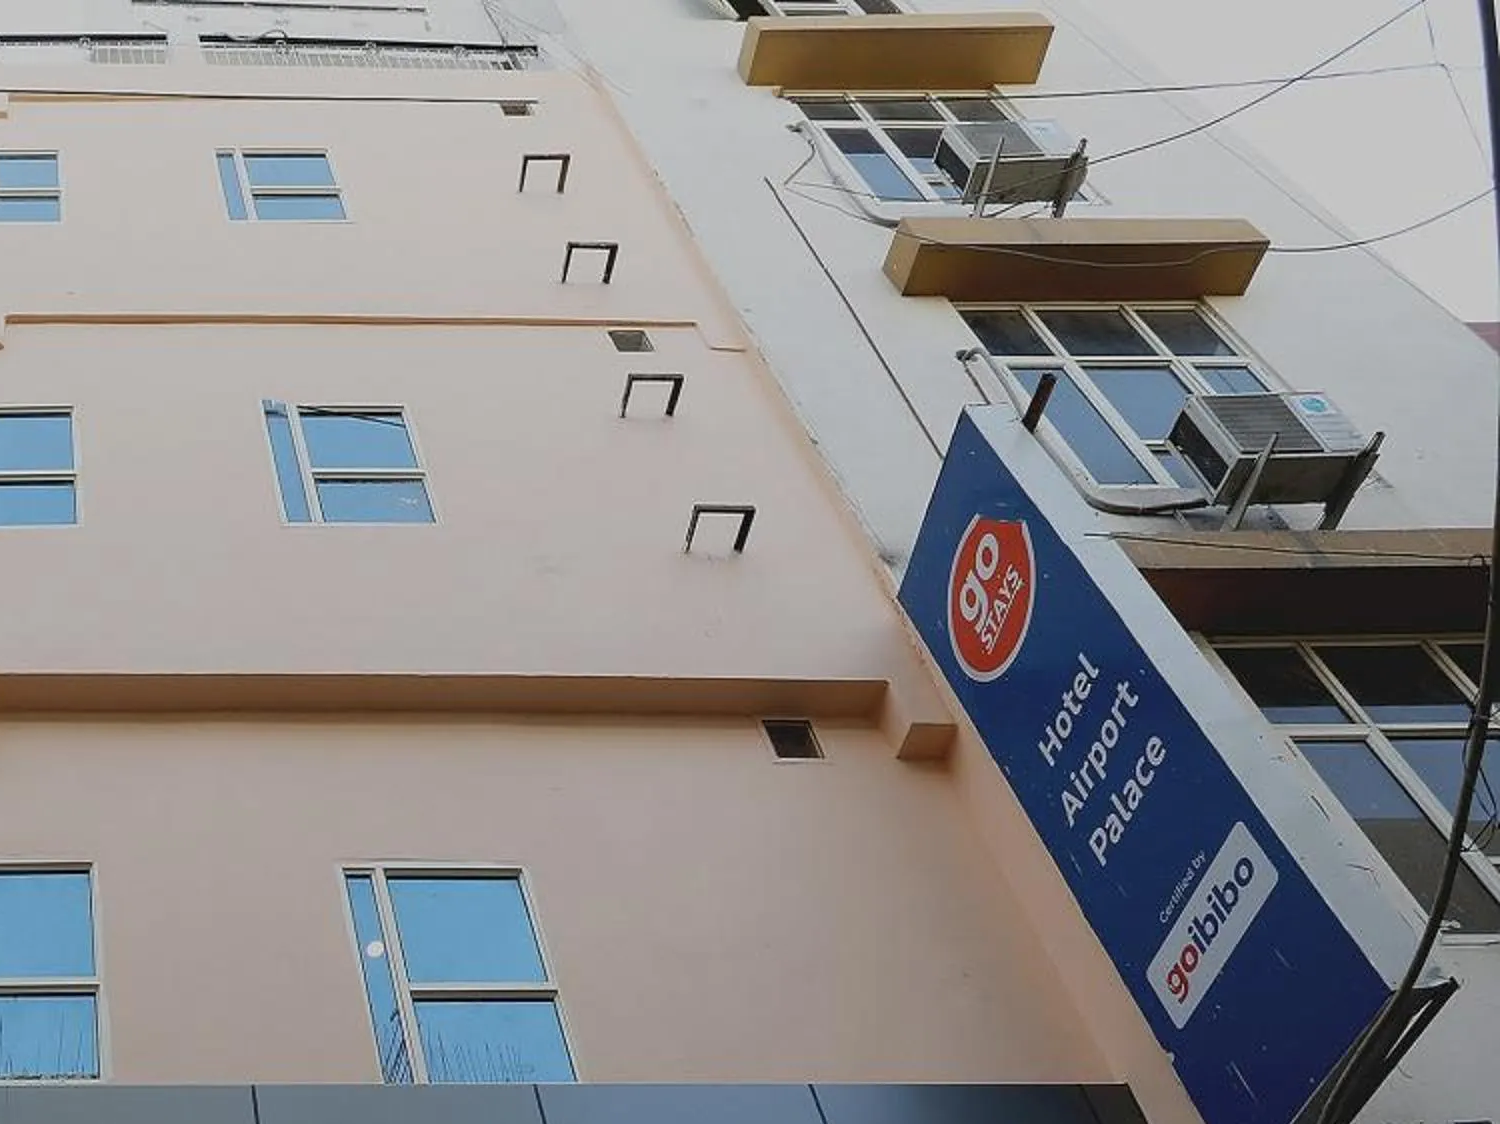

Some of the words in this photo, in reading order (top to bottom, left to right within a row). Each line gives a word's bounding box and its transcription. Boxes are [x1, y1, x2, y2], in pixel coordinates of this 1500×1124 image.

[959, 533, 1000, 634] go
[981, 563, 1024, 655] STAYS
[1038, 651, 1100, 768] Hotel
[1060, 680, 1139, 829] Airport
[1088, 735, 1167, 868] Palace
[1159, 866, 1196, 924] Certified
[1191, 849, 1207, 870] by
[1165, 856, 1255, 1005] goibibo
